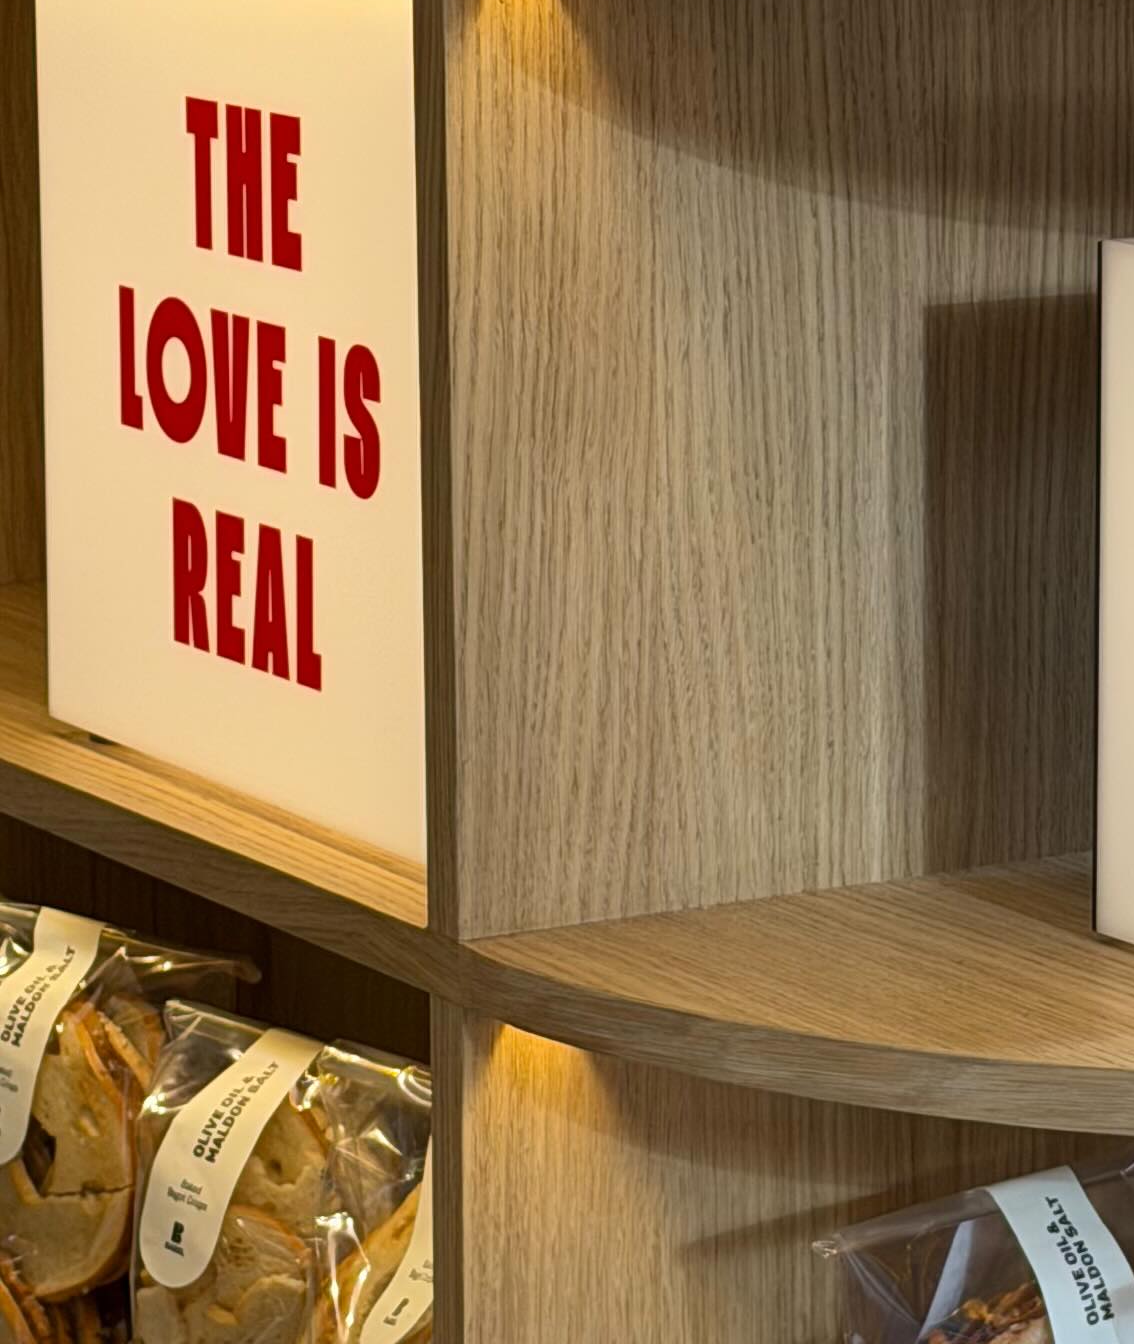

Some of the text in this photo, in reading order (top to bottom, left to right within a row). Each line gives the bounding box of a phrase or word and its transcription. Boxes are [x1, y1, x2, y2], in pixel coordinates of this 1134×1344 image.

[185, 96, 303, 272] THE
[119, 285, 381, 500] LOVE IS
[172, 497, 323, 692] REAL
[1, 996, 26, 1042] OLIVE
[24, 976, 46, 993] OIL
[11, 945, 75, 1048] MALDON SALT
[193, 1109, 225, 1158] OLIVE
[220, 1087, 245, 1107] OIL
[205, 1061, 279, 1163] MALDON SALT
[171, 1220, 184, 1245] B
[1045, 1196, 1115, 1321] MALDON SALT
[1046, 1221, 1100, 1326] OLIVE OIL &
